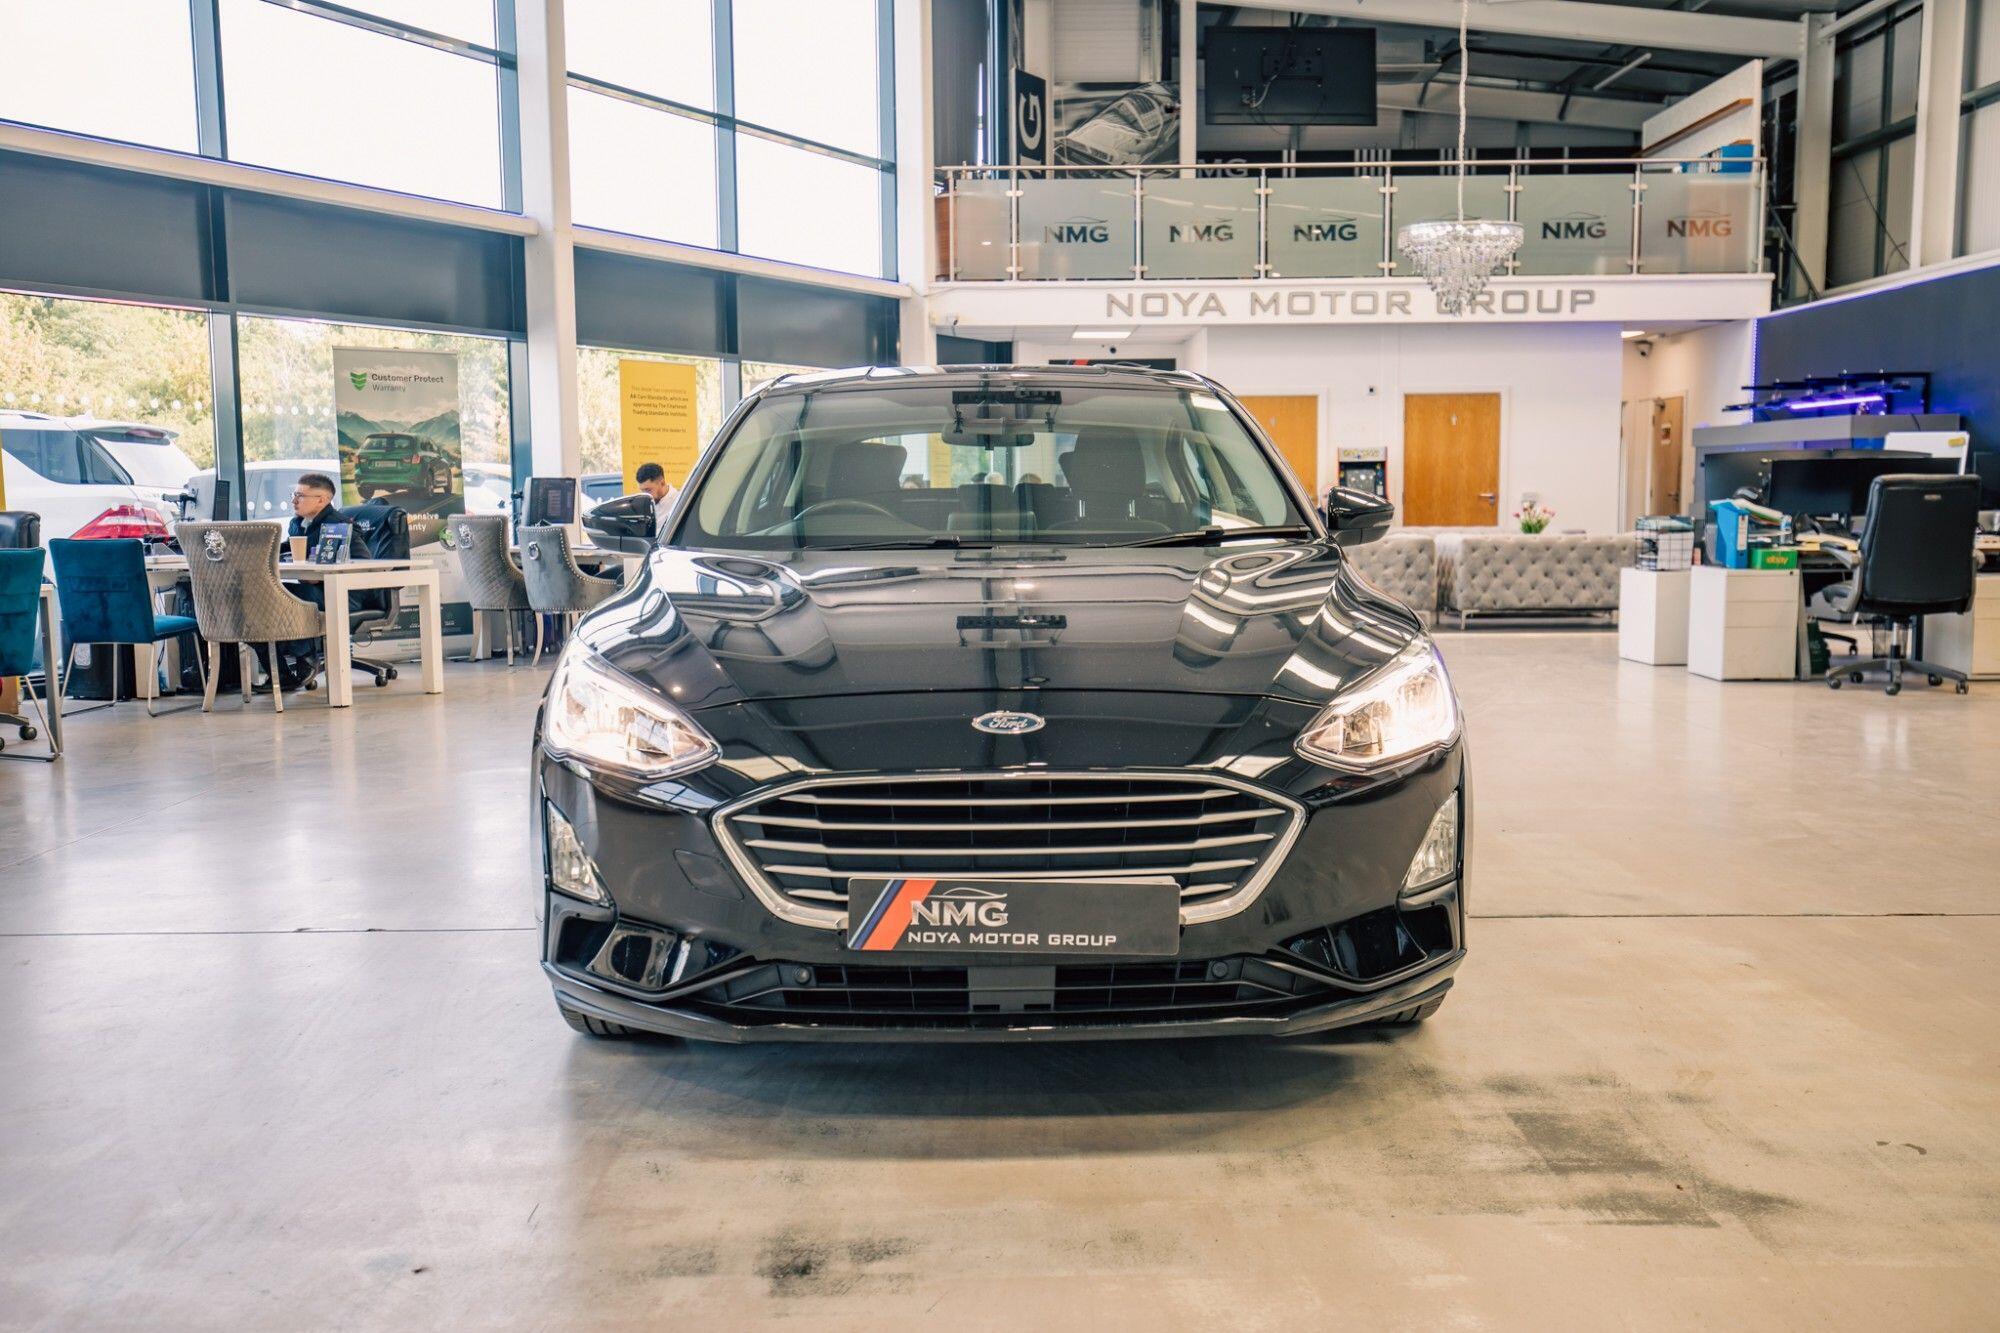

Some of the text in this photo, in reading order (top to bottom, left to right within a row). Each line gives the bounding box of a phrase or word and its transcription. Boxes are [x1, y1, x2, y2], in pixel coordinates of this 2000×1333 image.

[1197, 158, 1249, 178] MG
[1045, 225, 1109, 243] NMG
[1170, 224, 1234, 242] NMG
[1293, 223, 1359, 242] NMG
[1542, 220, 1606, 239] NMG
[1667, 219, 1732, 238] NMG
[1106, 291, 1227, 317] NOYA
[1250, 290, 1412, 316] MOTOR
[371, 373, 444, 383] Customer Protect
[372, 384, 406, 392] Warranty
[407, 512, 439, 521] hensive
[409, 523, 427, 532] anty
[988, 716, 1028, 730] Ford
[910, 900, 1009, 928] NMG
[908, 931, 1117, 947] NOYA MOTOR GROUP
